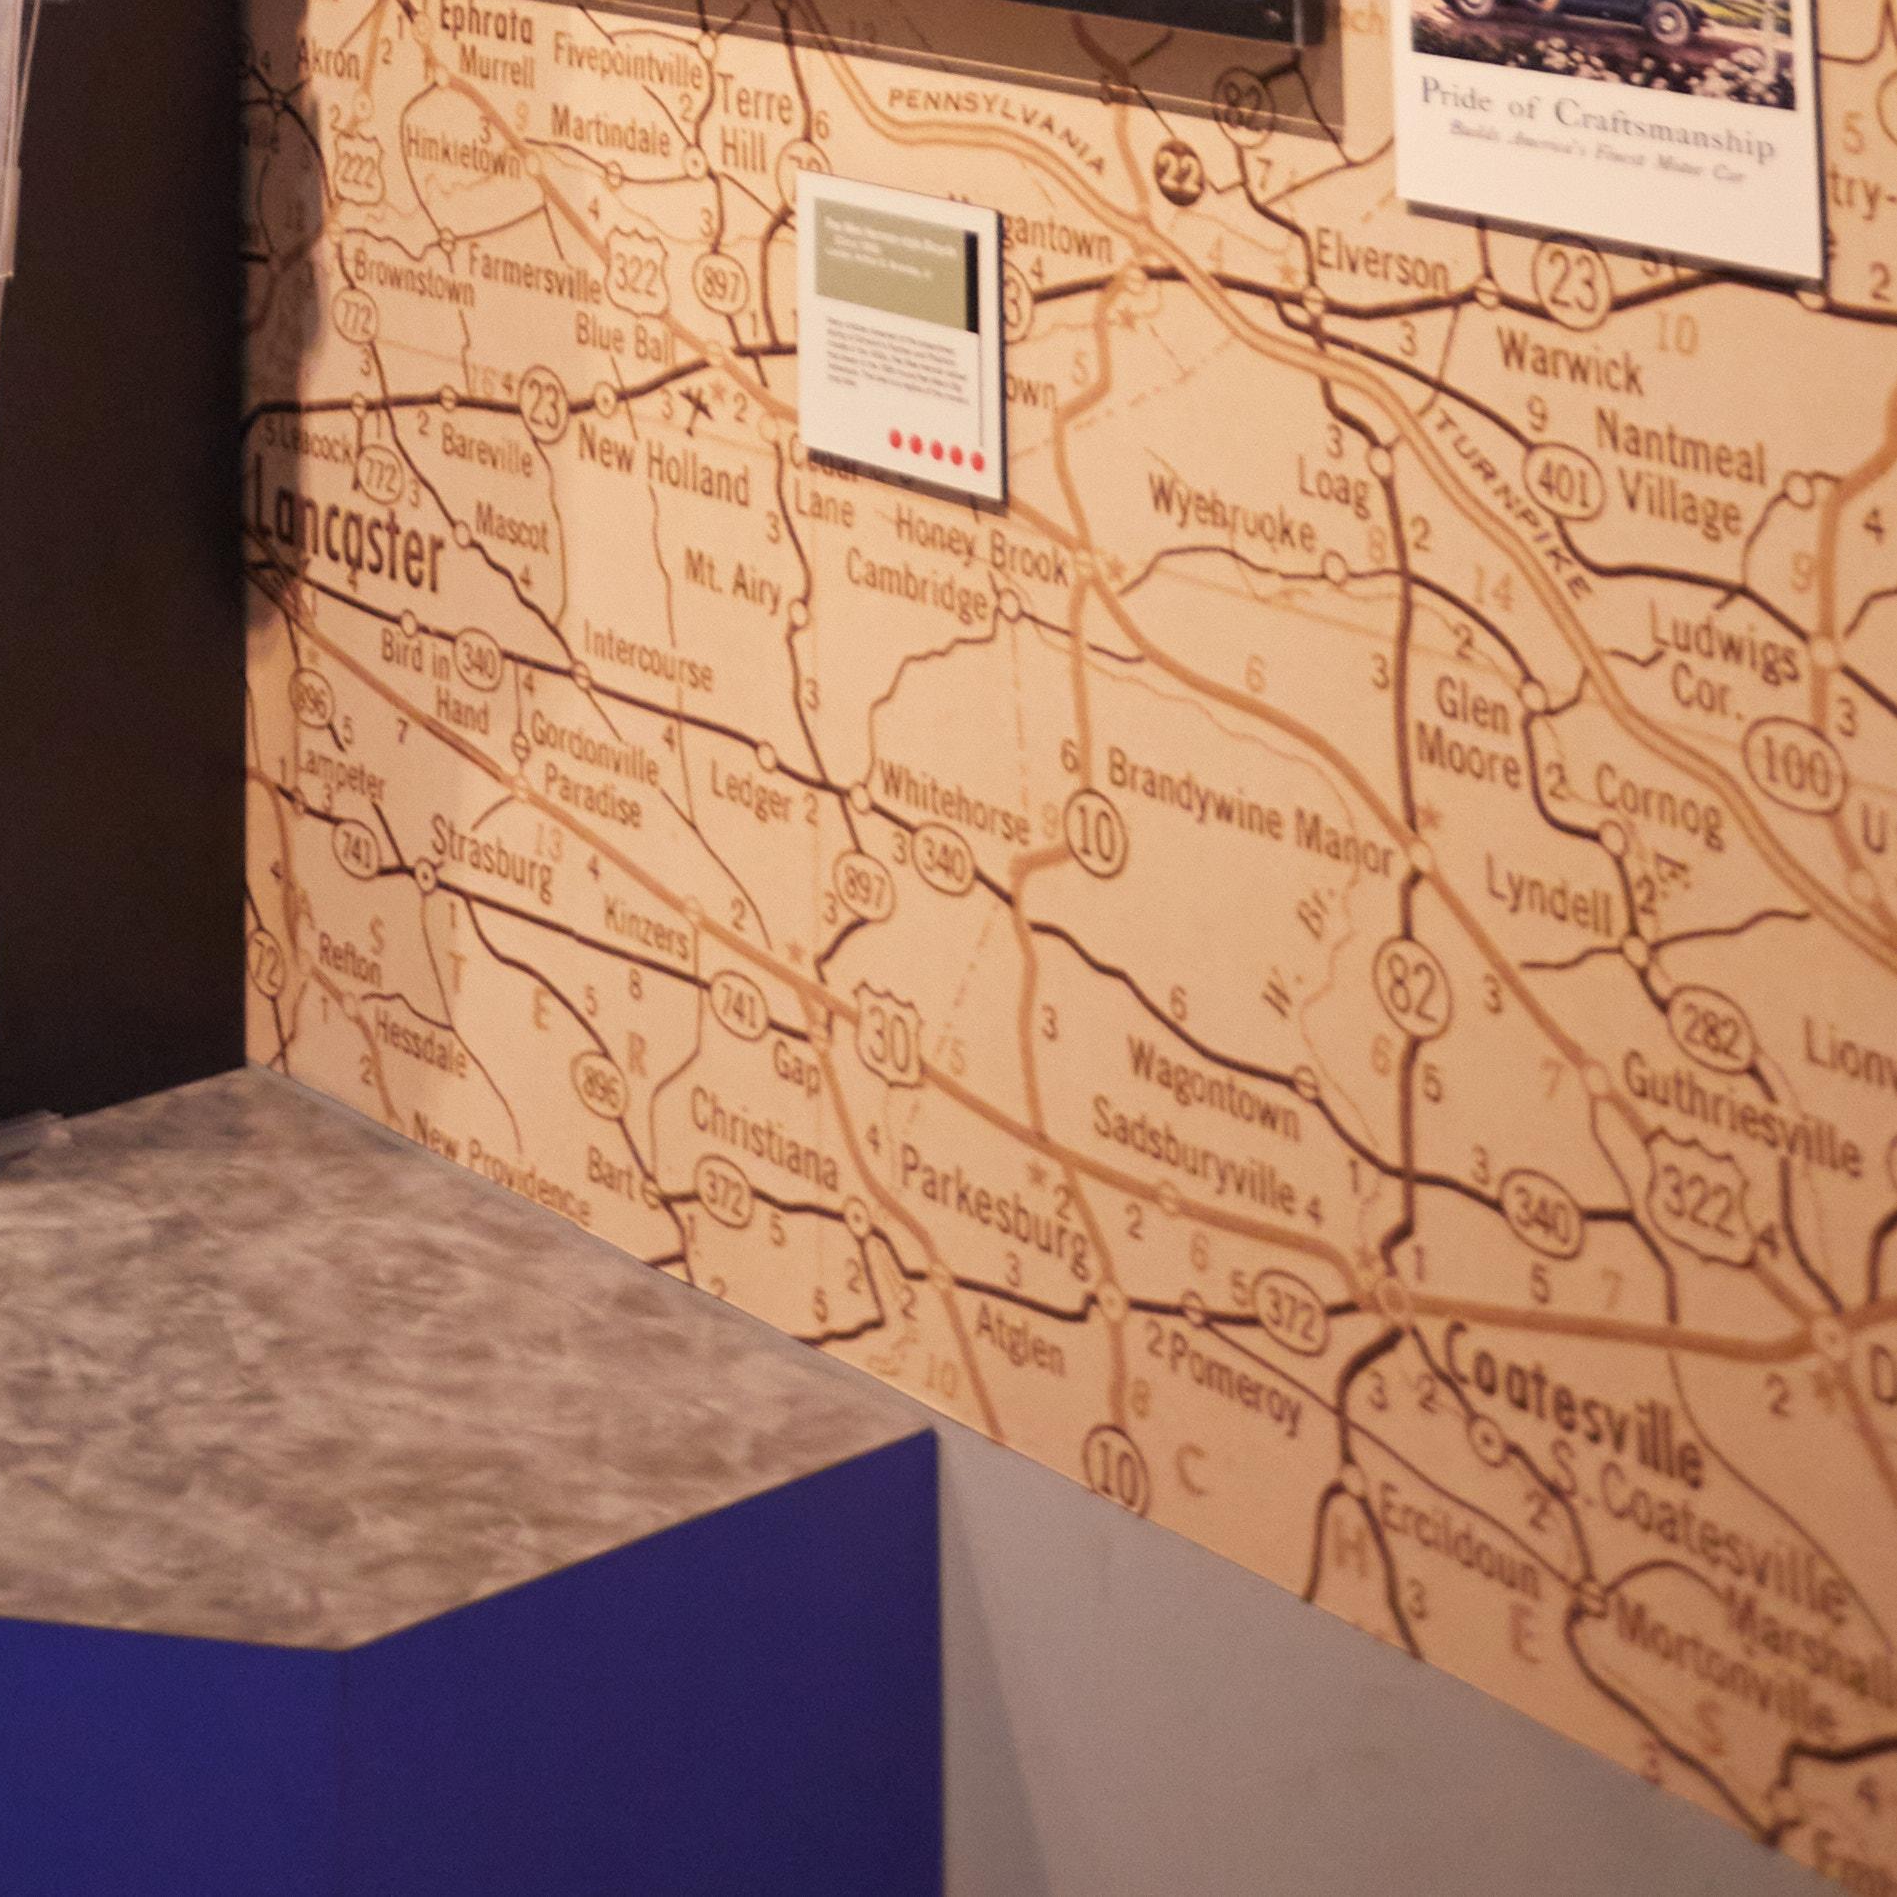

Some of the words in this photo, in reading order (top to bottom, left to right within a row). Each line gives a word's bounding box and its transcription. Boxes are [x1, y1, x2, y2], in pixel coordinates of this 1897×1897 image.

[551, 105, 670, 157] Martindale
[891, 85, 1105, 174] PENNSYLVANIA
[1420, 76, 1492, 113] Pride
[1509, 96, 1540, 121] of
[1555, 98, 1776, 165] Craftsmanship
[468, 246, 602, 306] Farmersville
[1314, 226, 1450, 294] Elverson
[1496, 325, 1645, 397] Warwick
[577, 416, 635, 476] New
[647, 440, 751, 507] Holland
[1595, 406, 1769, 486] Nantmeal
[255, 455, 446, 592] Lancaster
[1432, 409, 1593, 600] TURNPIKE
[1618, 467, 1744, 542] Village
[584, 620, 714, 691] Intercourse
[1650, 600, 1799, 686] Ludwigs
[1434, 675, 1511, 734] Glen
[1416, 721, 1522, 788] Moore
[1108, 746, 1284, 841] Brandywine
[1295, 809, 1393, 876] Manor
[1596, 763, 1725, 852] Cornog
[432, 816, 553, 902] Strasburg
[1387, 953, 1438, 1021] 82
[868, 1014, 913, 1073] 30
[1127, 1036, 1302, 1143] Wagontown
[1623, 1050, 1863, 1179] Guthriesville
[902, 1145, 1091, 1281] Parkesburg
[1443, 1323, 1703, 1488] Coatesville
